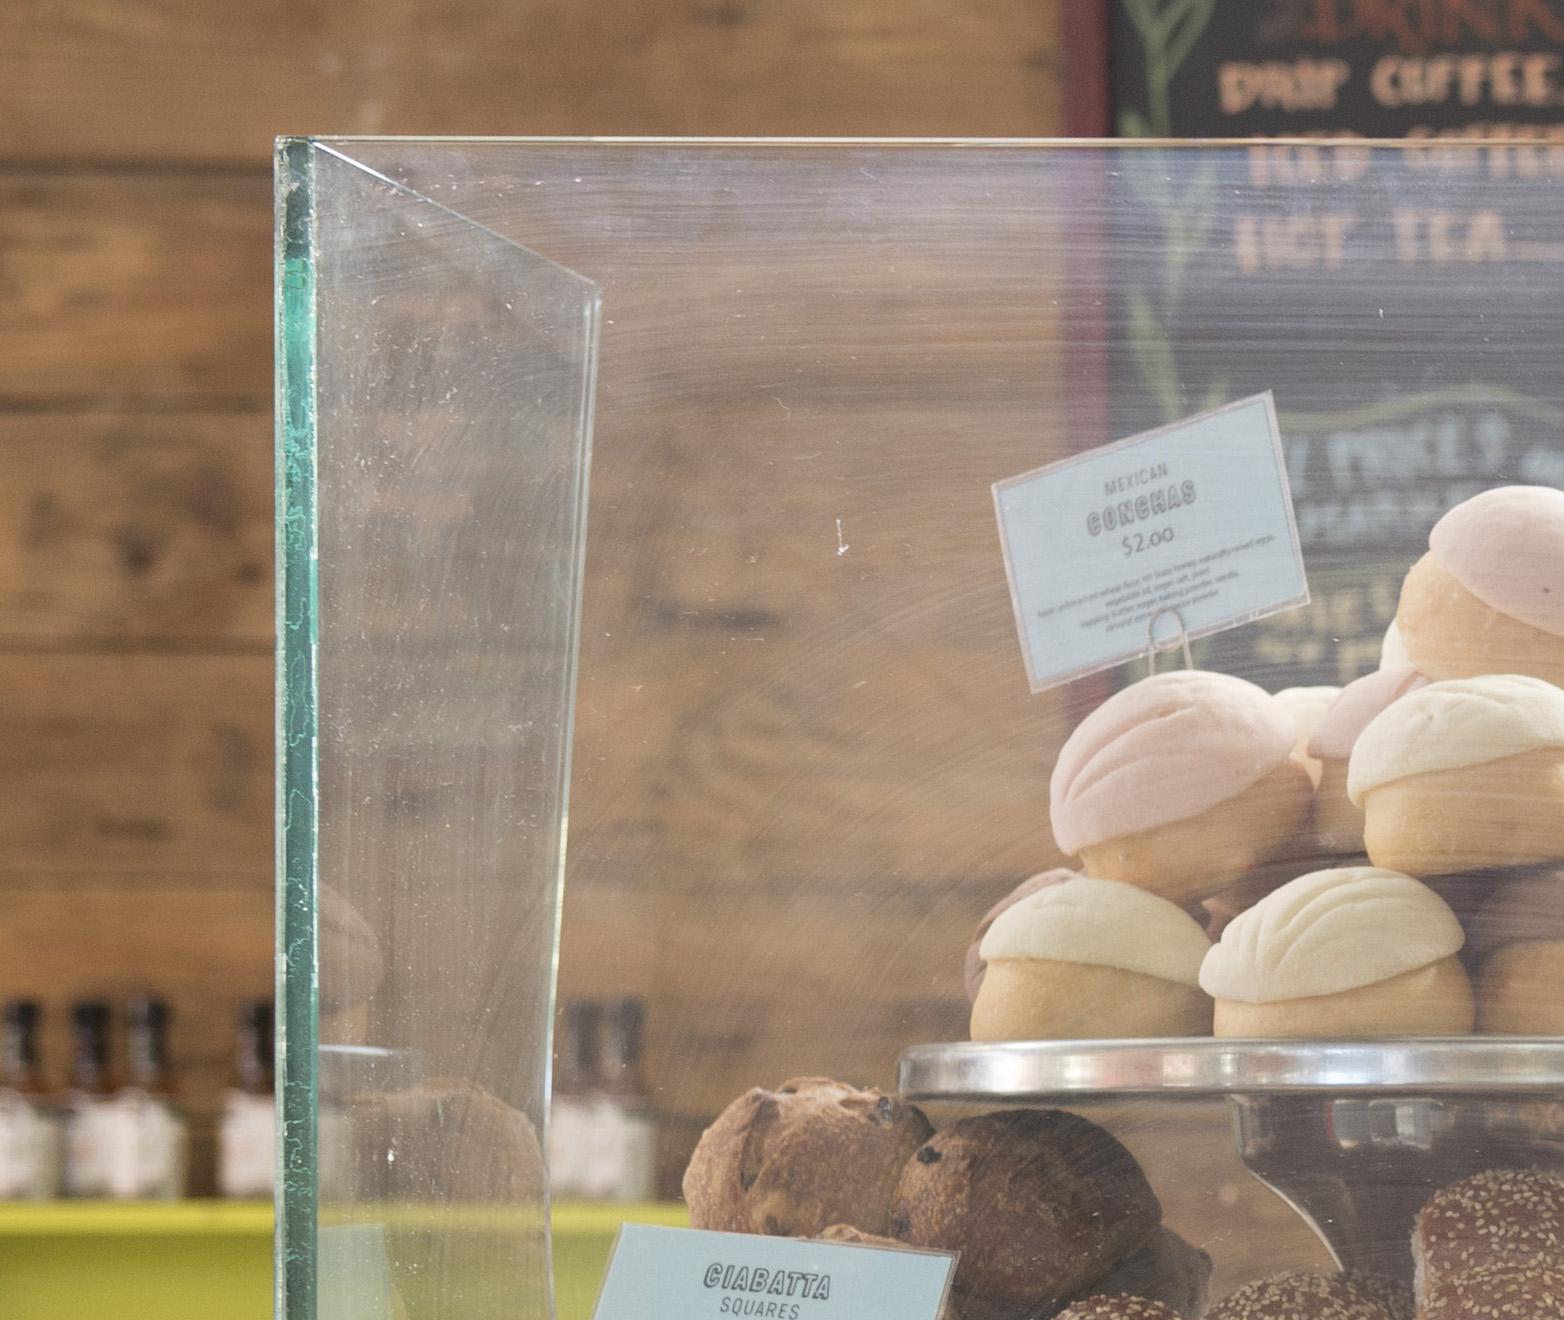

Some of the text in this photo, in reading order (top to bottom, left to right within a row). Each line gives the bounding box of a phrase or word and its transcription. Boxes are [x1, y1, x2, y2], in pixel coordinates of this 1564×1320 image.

[1369, 52, 1562, 107] COFFEE
[1104, 463, 1168, 496] MEXICAN
[1086, 480, 1198, 537] CONCHAS
[1121, 527, 1175, 558] $2.00
[703, 1262, 832, 1300] CIABATTA
[720, 1296, 800, 1320] SQUARES
